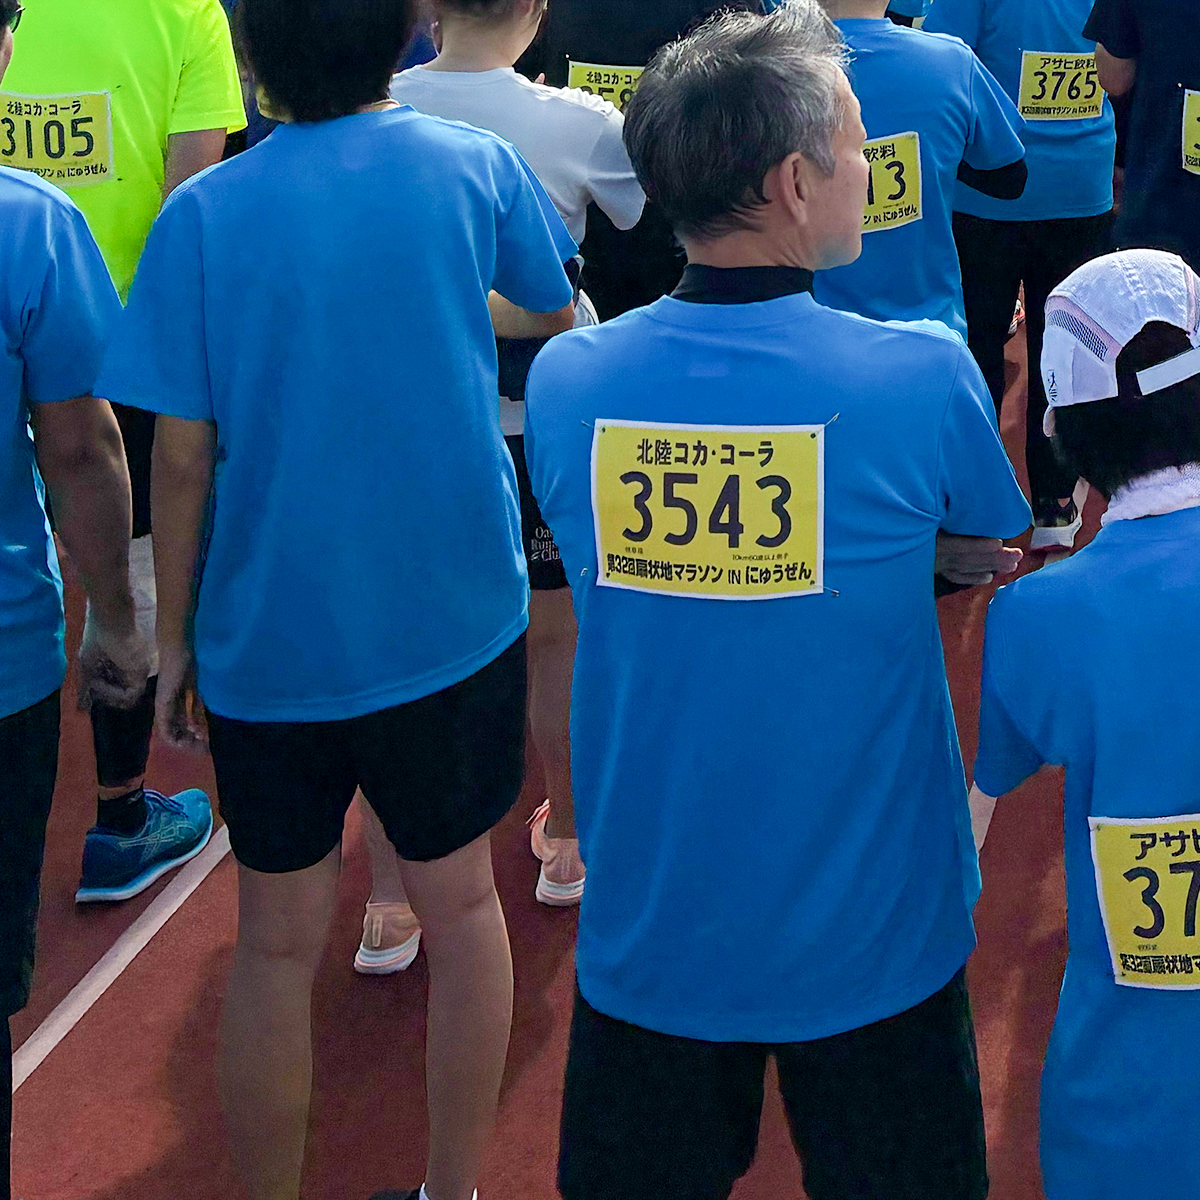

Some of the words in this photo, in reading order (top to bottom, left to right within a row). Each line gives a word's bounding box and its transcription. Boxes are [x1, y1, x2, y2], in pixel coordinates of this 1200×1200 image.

[1031, 71, 1097, 100] 3765
[1, 117, 94, 159] 3105
[867, 161, 906, 205] 13
[637, 438, 774, 467] 北陸コカ・コーラ
[620, 471, 792, 548] 3543
[607, 553, 723, 583] 第32回扇状地マラソン
[728, 569, 741, 584] IN
[746, 561, 812, 585] にゅうぜん
